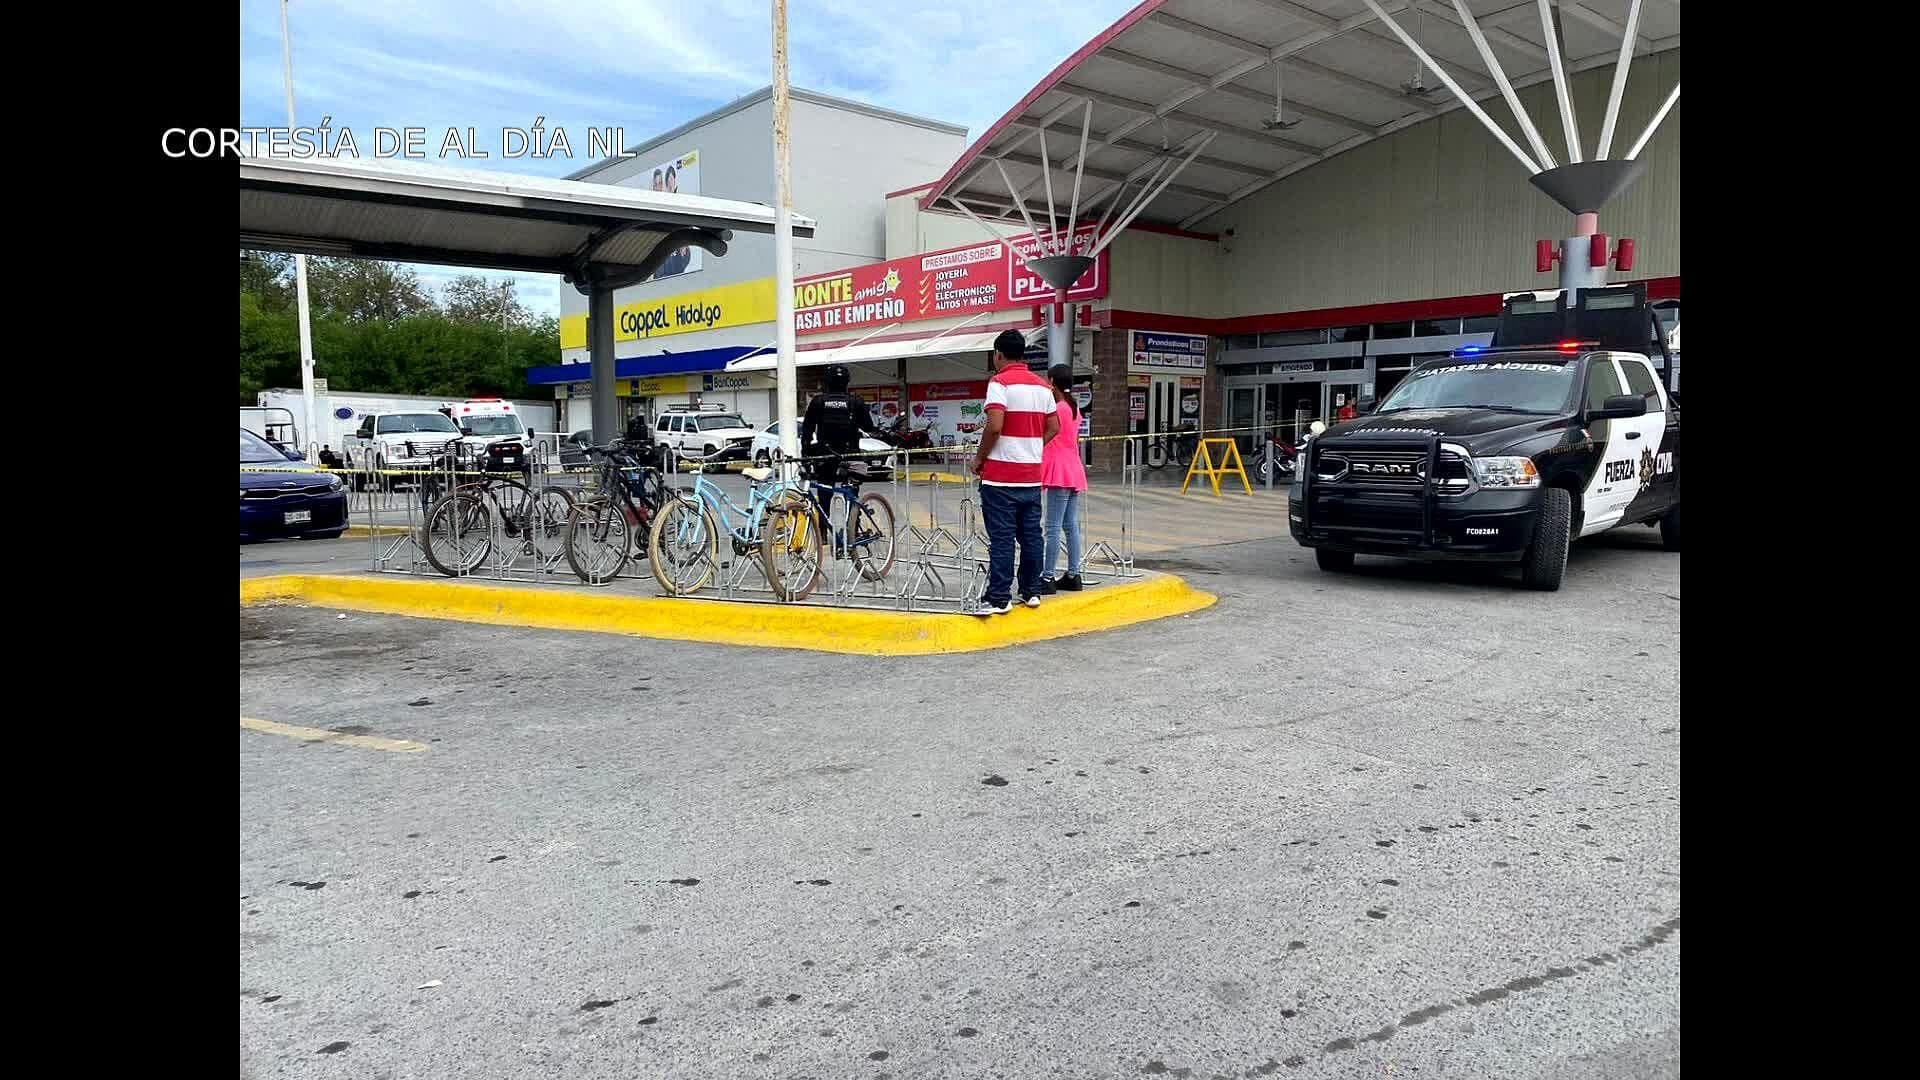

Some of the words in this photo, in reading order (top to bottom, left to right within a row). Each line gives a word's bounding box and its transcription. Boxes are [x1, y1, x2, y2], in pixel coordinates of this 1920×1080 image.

[925, 252, 968, 269] PRESTAMOS
[935, 268, 969, 280] JOYERIA
[793, 277, 853, 308] MONTE
[935, 281, 953, 291] ORO
[935, 284, 997, 301] ELECTRONICOS
[796, 312, 822, 330] ASA
[824, 308, 842, 327] DE
[844, 297, 905, 324] EMPEÑO
[935, 301, 961, 311] AUTOS
[620, 303, 671, 340] Coppel
[676, 301, 722, 327] Hidalgo
[1352, 462, 1412, 474] RAM
[1604, 458, 1635, 484] FUERZA
